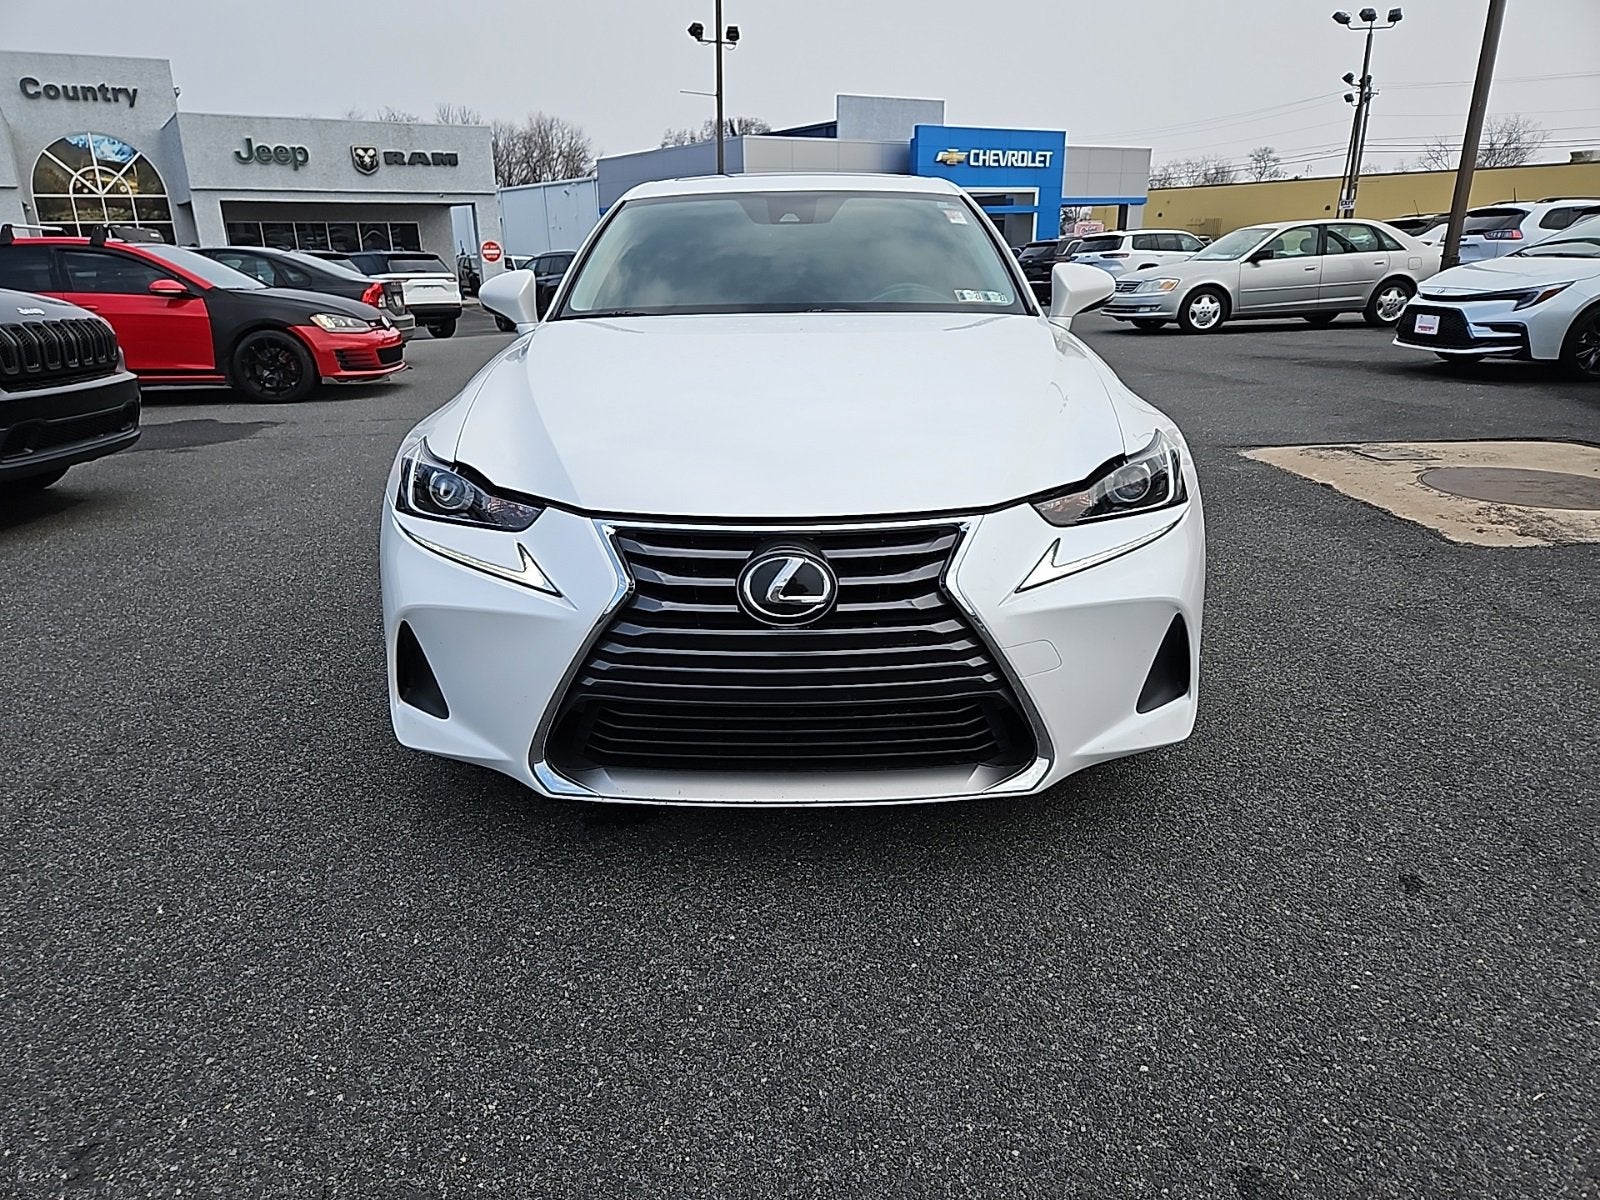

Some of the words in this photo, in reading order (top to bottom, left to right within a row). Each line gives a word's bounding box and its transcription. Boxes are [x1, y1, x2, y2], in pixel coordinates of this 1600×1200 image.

[19, 77, 138, 108] Country
[235, 137, 310, 170] Jeep
[383, 151, 459, 167] RAM
[969, 149, 1053, 168] CHEVROLET
